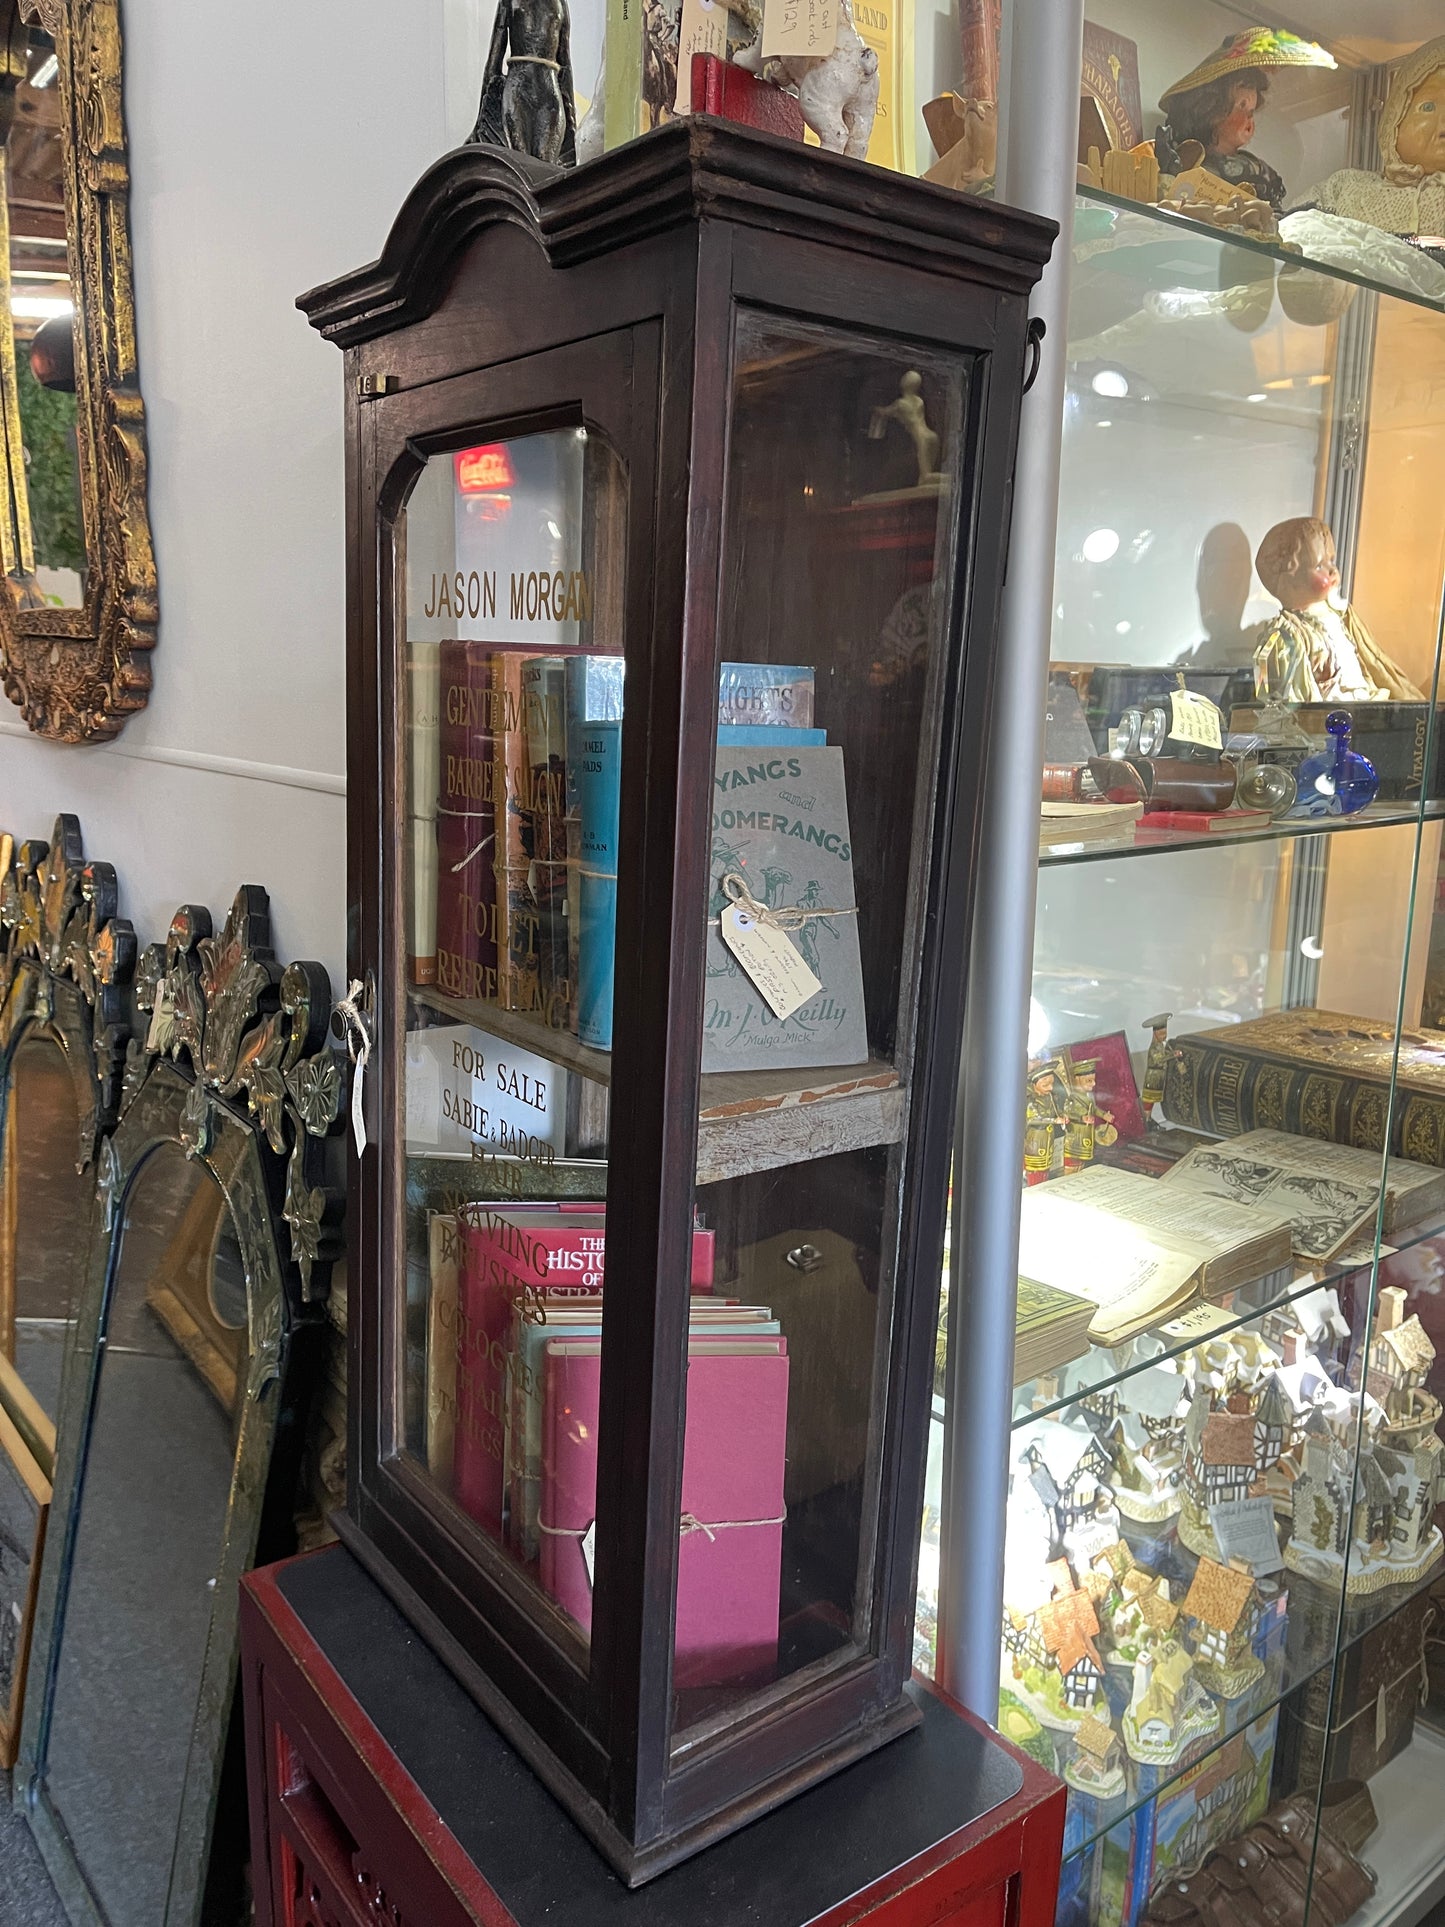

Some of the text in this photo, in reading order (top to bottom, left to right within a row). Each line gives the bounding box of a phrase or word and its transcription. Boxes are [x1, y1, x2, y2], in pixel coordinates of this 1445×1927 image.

[424, 571, 594, 621] JASON MORGAN
[779, 790, 817, 812] and
[452, 1040, 547, 1112] FOR SALE
[443, 1088, 489, 1139] SABIE
[491, 1127, 496, 1142] &
[500, 1118, 556, 1178] BADGER
[471, 1141, 523, 1198] HAIR
